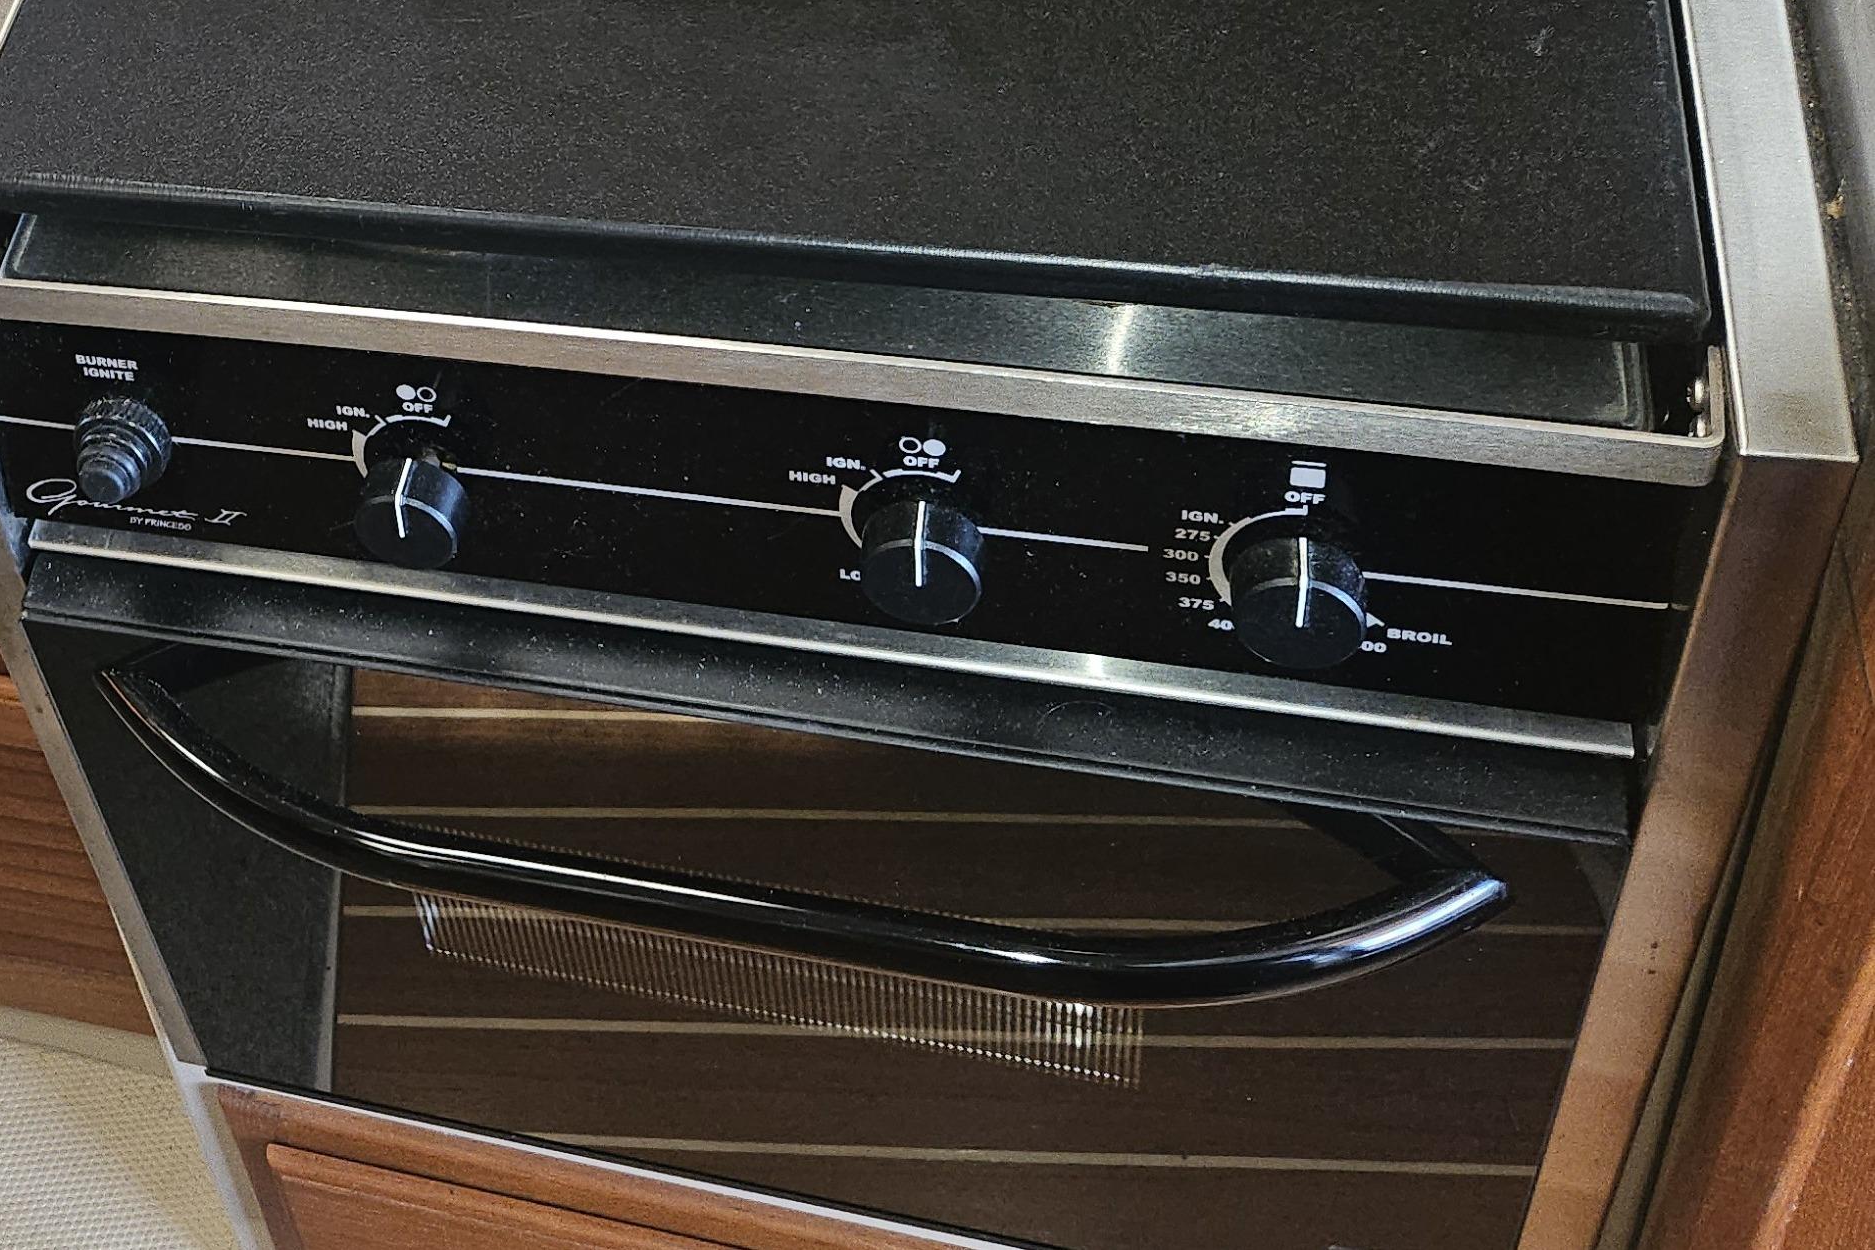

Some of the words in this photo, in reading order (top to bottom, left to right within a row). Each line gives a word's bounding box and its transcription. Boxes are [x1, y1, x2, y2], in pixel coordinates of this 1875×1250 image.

[75, 354, 138, 370] BURNER
[83, 367, 135, 382] IGNITE
[335, 405, 370, 418] IGN.
[402, 401, 433, 413] OFF
[306, 417, 348, 431] HIGH
[826, 456, 866, 471] IGN.
[902, 455, 940, 468] OFF
[788, 470, 836, 485] HIGH
[26, 478, 199, 520] Gourmet
[1284, 490, 1325, 505] OFF
[129, 516, 143, 526] BY
[1181, 509, 1224, 525] IGN.
[1175, 528, 1211, 542] 275
[1163, 548, 1199, 562] 300
[839, 568, 862, 581] LO
[1165, 571, 1201, 585] 350
[1178, 596, 1215, 611] 375
[1208, 618, 1235, 631] 40
[1386, 628, 1453, 646] BROIL
[1361, 639, 1387, 653] 00
